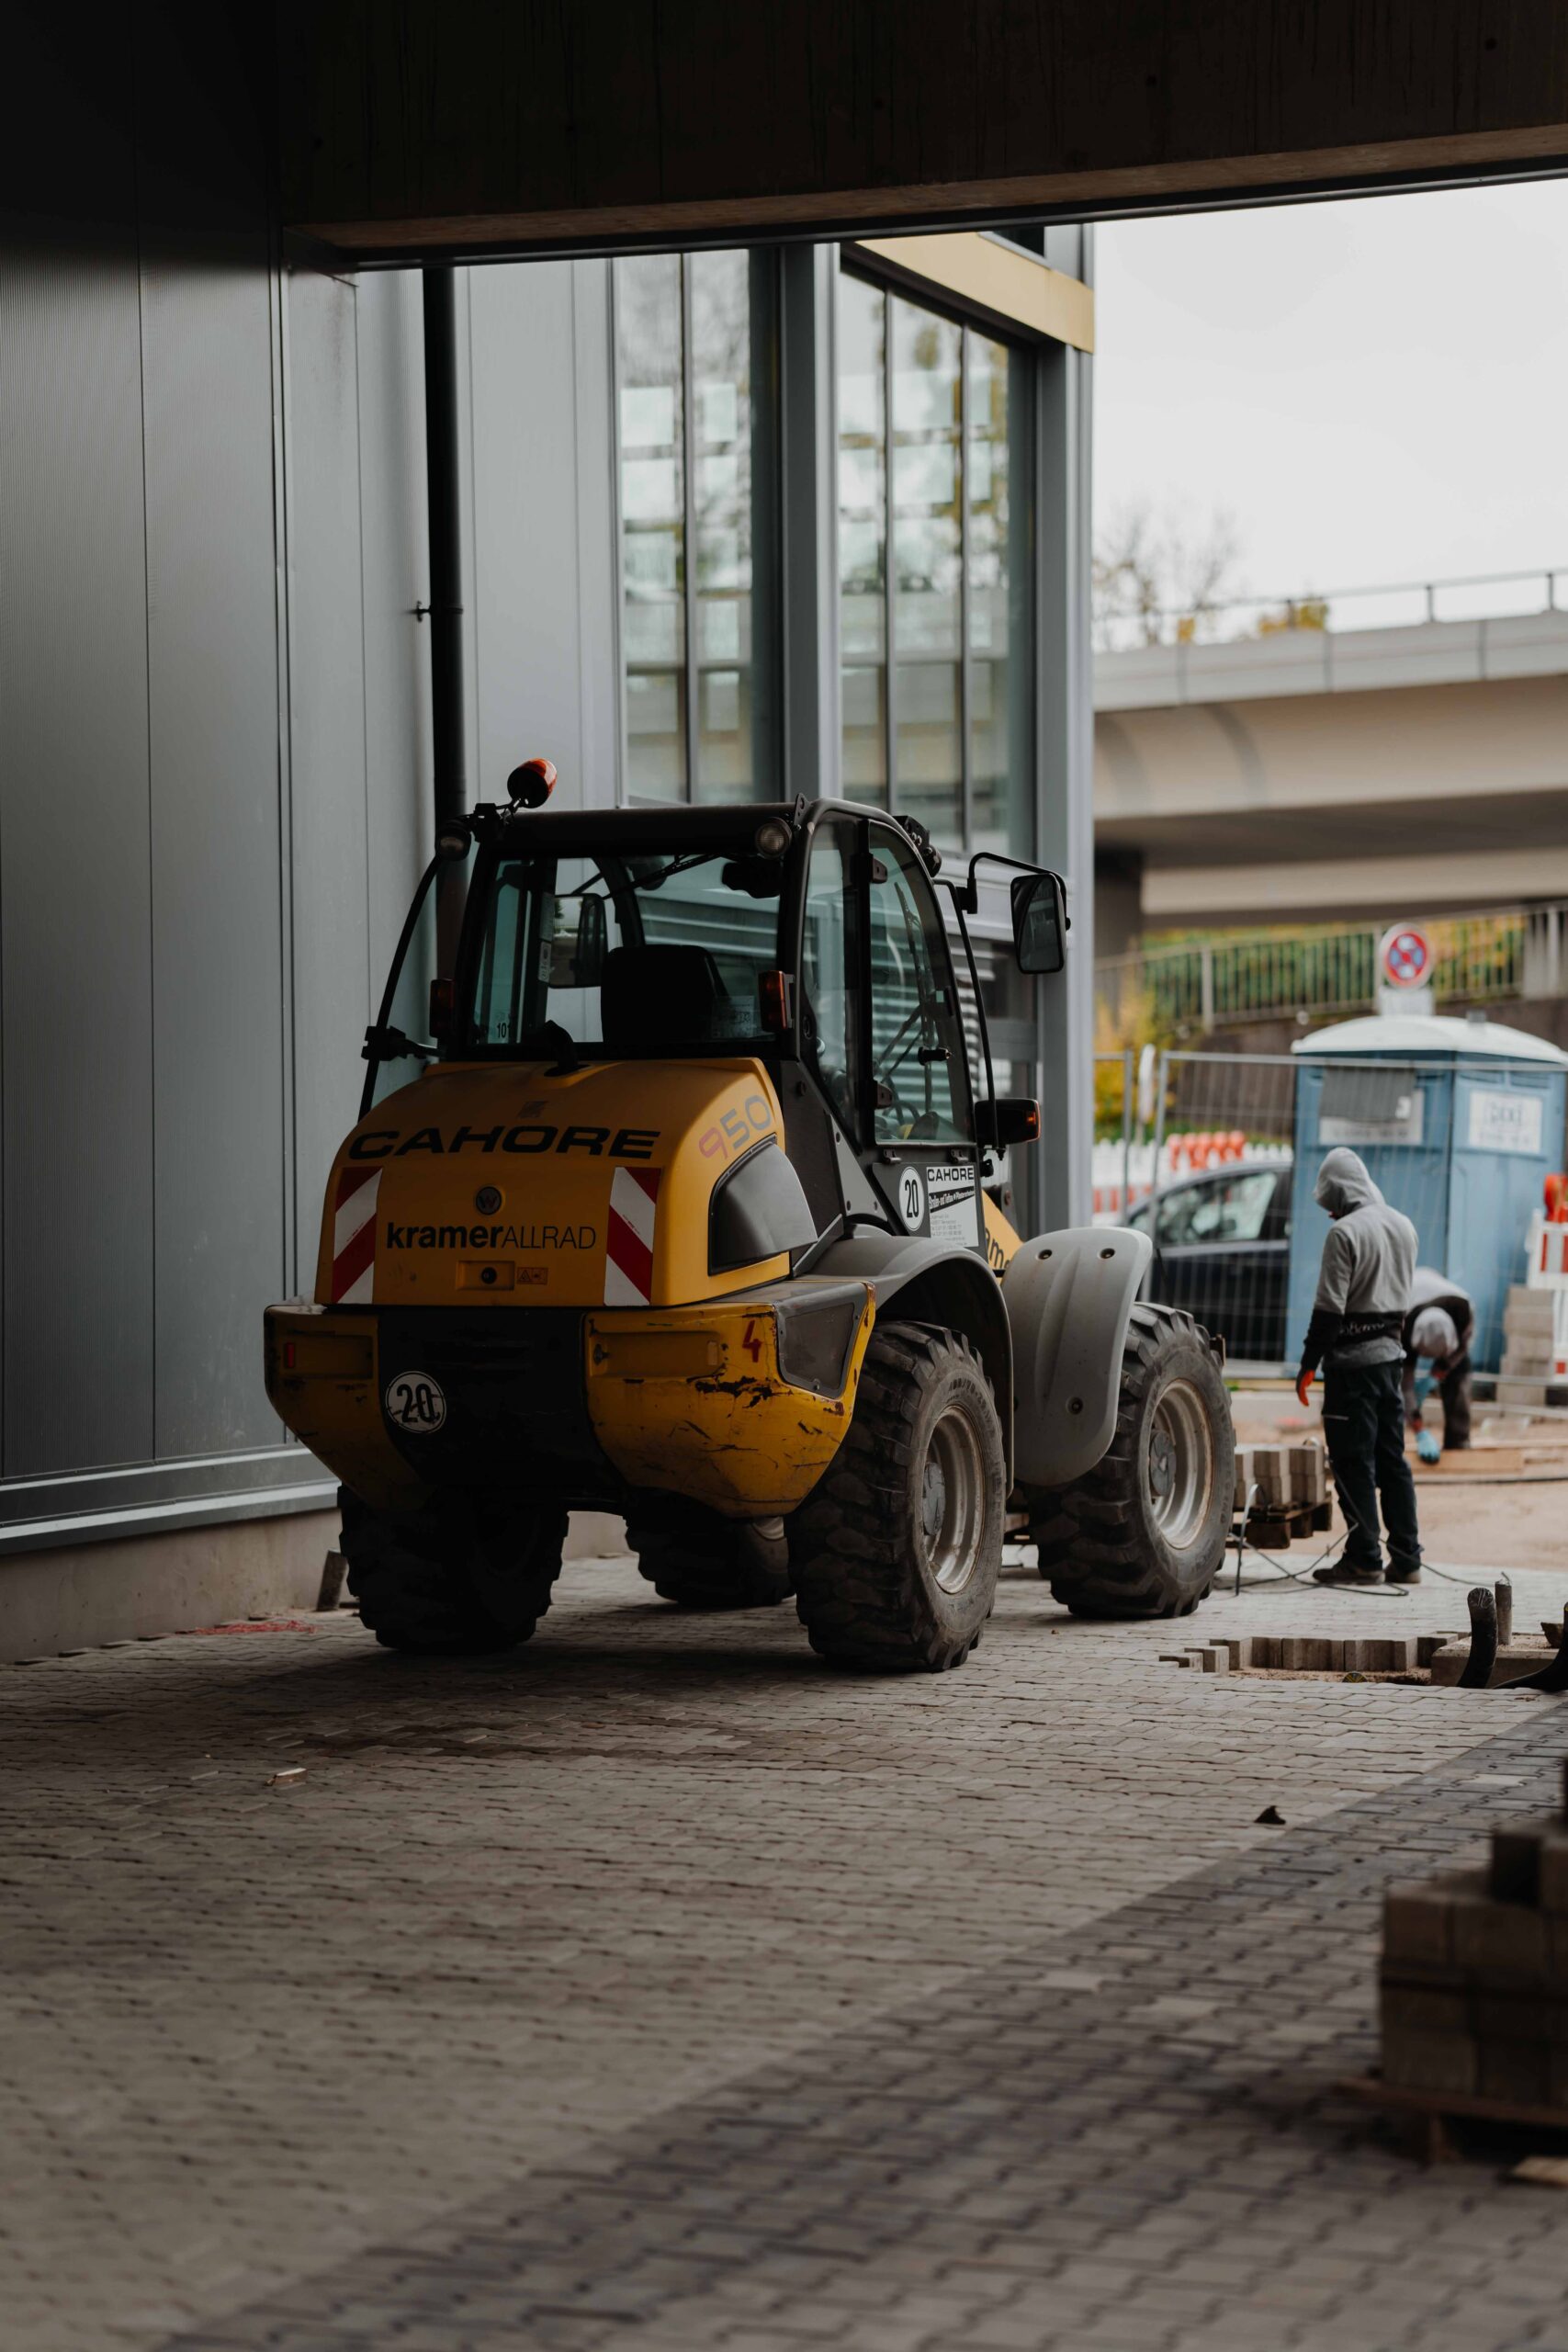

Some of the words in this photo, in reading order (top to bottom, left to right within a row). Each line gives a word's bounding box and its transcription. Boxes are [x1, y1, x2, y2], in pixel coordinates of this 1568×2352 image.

[348, 1125, 661, 1160] CAHORE
[698, 1094, 772, 1160] 950
[927, 1168, 975, 1182] CAHORE
[904, 1179, 919, 1218] 20
[742, 1319, 763, 1363] 4
[396, 1383, 435, 1423] 20
